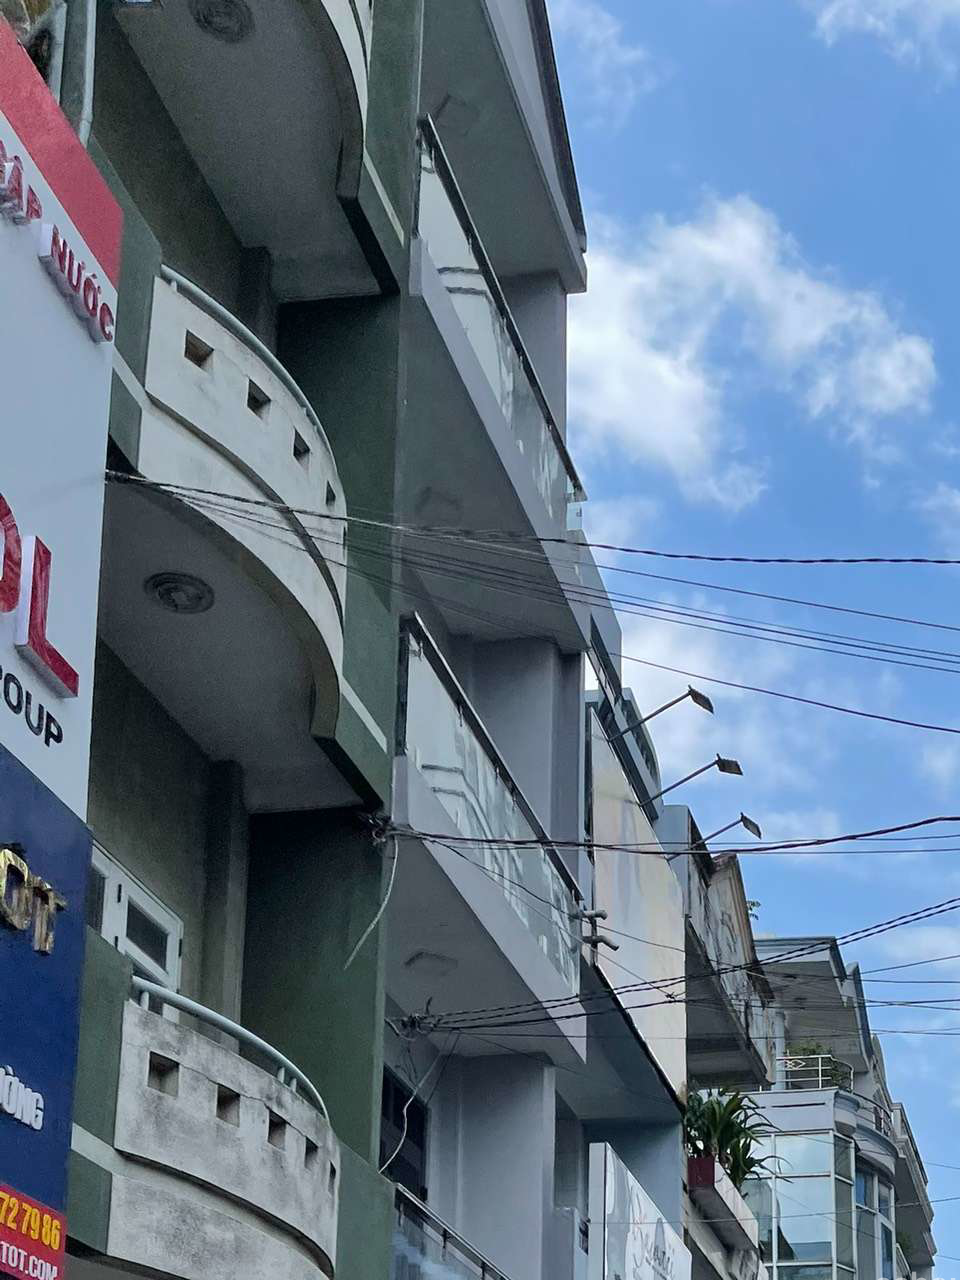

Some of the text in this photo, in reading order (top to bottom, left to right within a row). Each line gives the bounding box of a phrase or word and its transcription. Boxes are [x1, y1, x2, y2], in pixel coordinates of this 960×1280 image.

[0, 664, 64, 748] OUP
[21, 1203, 41, 1240] 79
[42, 1214, 61, 1250] 86
